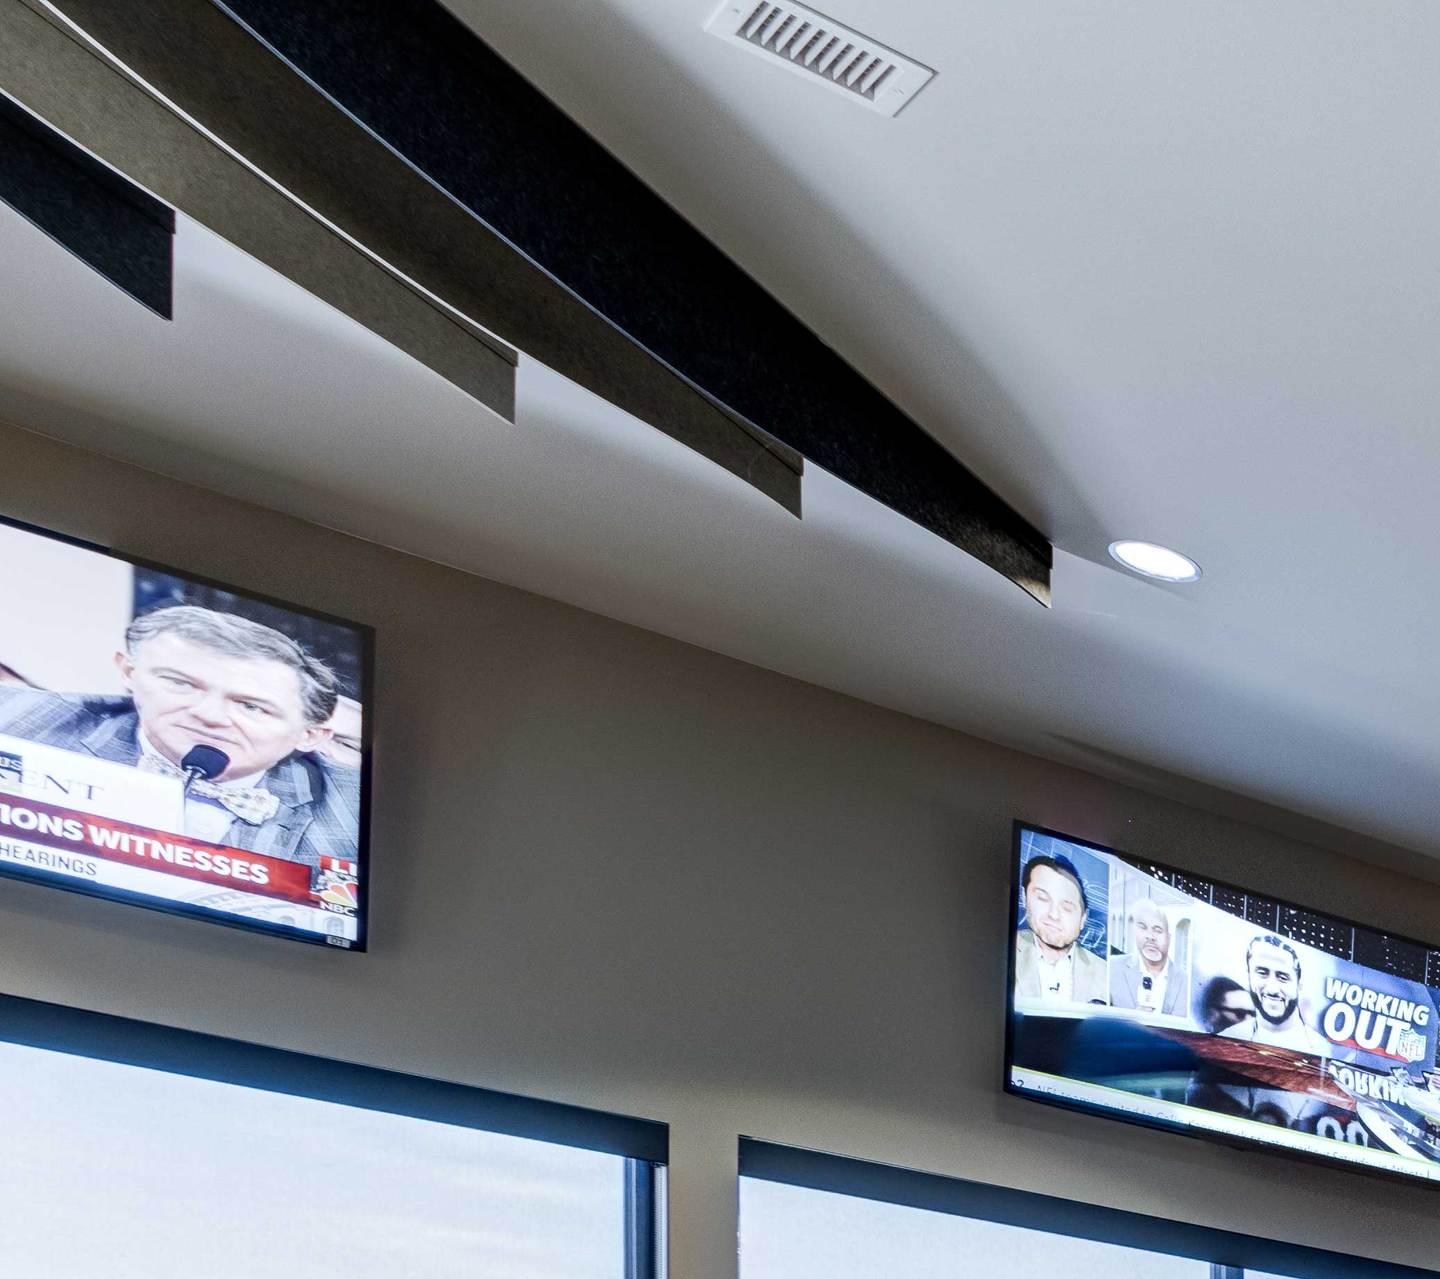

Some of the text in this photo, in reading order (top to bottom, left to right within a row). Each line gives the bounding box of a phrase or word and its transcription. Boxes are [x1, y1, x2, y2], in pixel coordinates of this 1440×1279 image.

[0, 843, 97, 876] HEARINGS
[87, 823, 269, 884] WITNESSES
[320, 901, 358, 917] NBC
[1325, 976, 1430, 1026] WORKING
[1324, 1002, 1411, 1056] OUT
[1402, 1042, 1422, 1060] NFL
